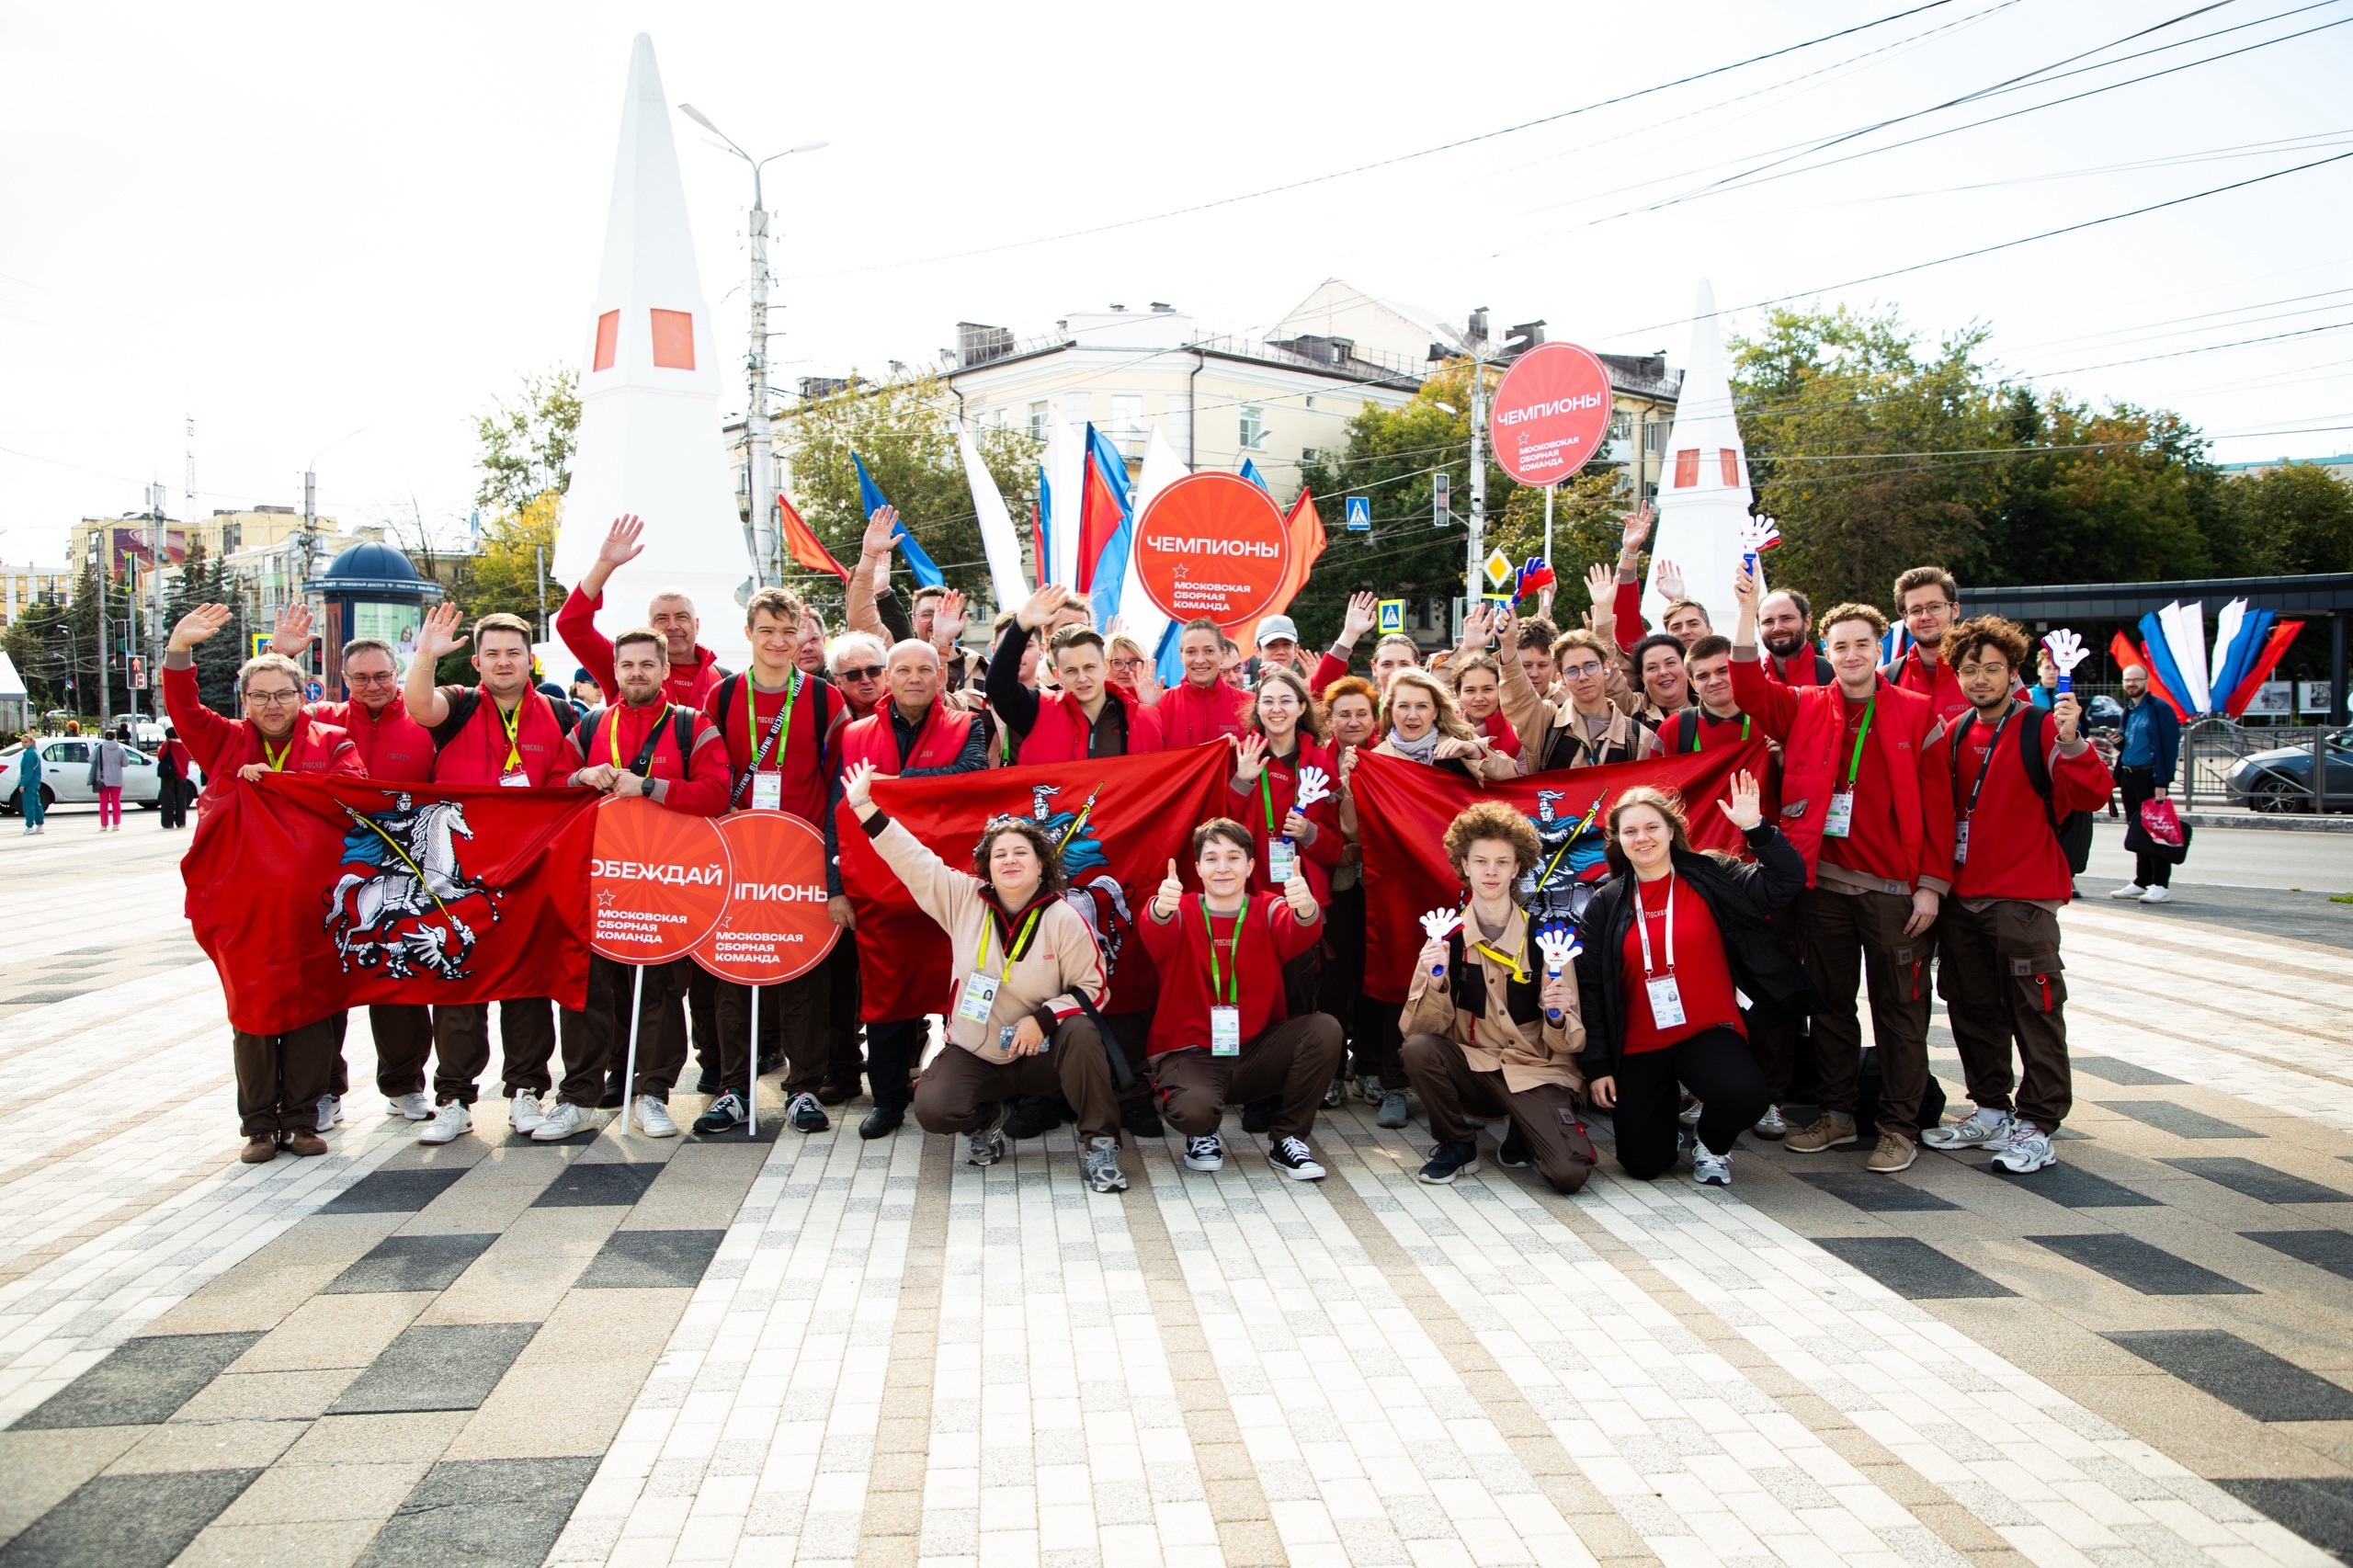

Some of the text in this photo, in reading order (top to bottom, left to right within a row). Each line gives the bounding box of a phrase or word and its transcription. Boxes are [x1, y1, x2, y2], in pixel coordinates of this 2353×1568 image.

[1497, 392, 1601, 426] ЧЕМПИОНЫ
[1518, 436, 1580, 456] МОСКОВСКАЯ
[1518, 449, 1560, 464] СБОРНАЯ
[1519, 457, 1564, 473] КОМАНДА
[1146, 535, 1280, 559] ЧЕМПИОНЫ
[1174, 581, 1252, 594] МОСКОВСКАЯ
[1173, 591, 1227, 602] СБОРНАЯ
[1173, 600, 1232, 612] КОМАНДА
[135, 673, 146, 688] 13
[521, 744, 545, 753] МОСКВА
[301, 761, 326, 769] МОСКВА
[653, 756, 667, 765] СКВА
[590, 858, 723, 886] ОБЕЖДАЙ
[597, 909, 688, 925] МОСКОВСКАЯ
[597, 920, 658, 933] СБОРНАЯ
[596, 930, 663, 944] КОМАНДА
[715, 931, 803, 943] МОСКОВСКАЯ
[715, 942, 775, 953] СБОРНАЯ
[714, 953, 780, 964] КОМАНДА
